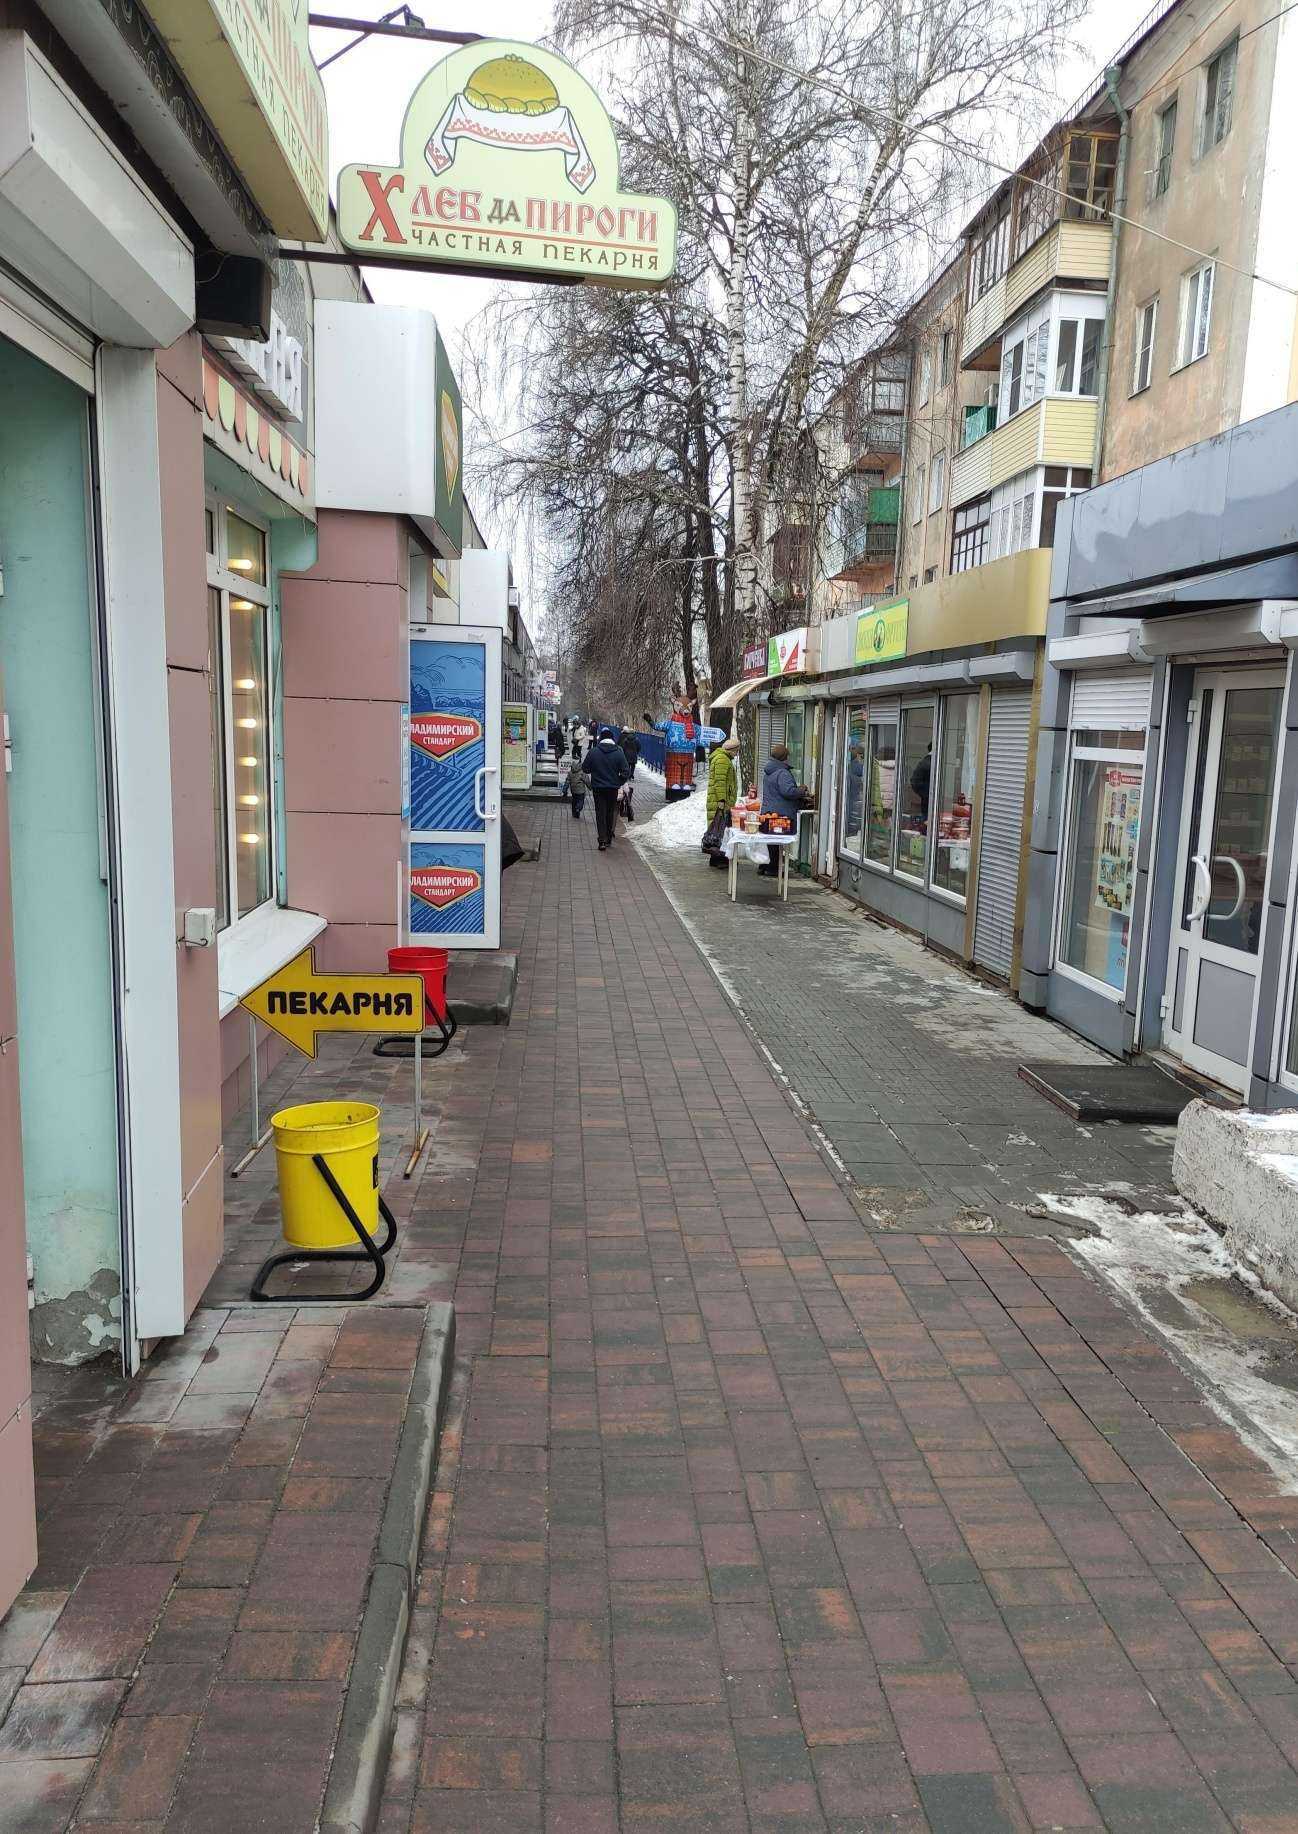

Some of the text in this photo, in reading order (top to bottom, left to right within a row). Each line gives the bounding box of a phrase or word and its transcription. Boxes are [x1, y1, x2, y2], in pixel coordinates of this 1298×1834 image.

[357, 169, 658, 245] ХЛЕБ ДА ПИРОГИ
[411, 228, 659, 271] ЧАСТНАЯ ПЕКАРНЯ
[410, 723, 474, 736] ЛАДИМИРСКИЙ
[422, 736, 456, 745] СТАНДАРТ
[410, 874, 474, 887] ЛАДИМИРСКИЙ
[424, 888, 455, 896] СТАНДАРТ
[267, 990, 413, 1016] ПЕКАРНЯ
